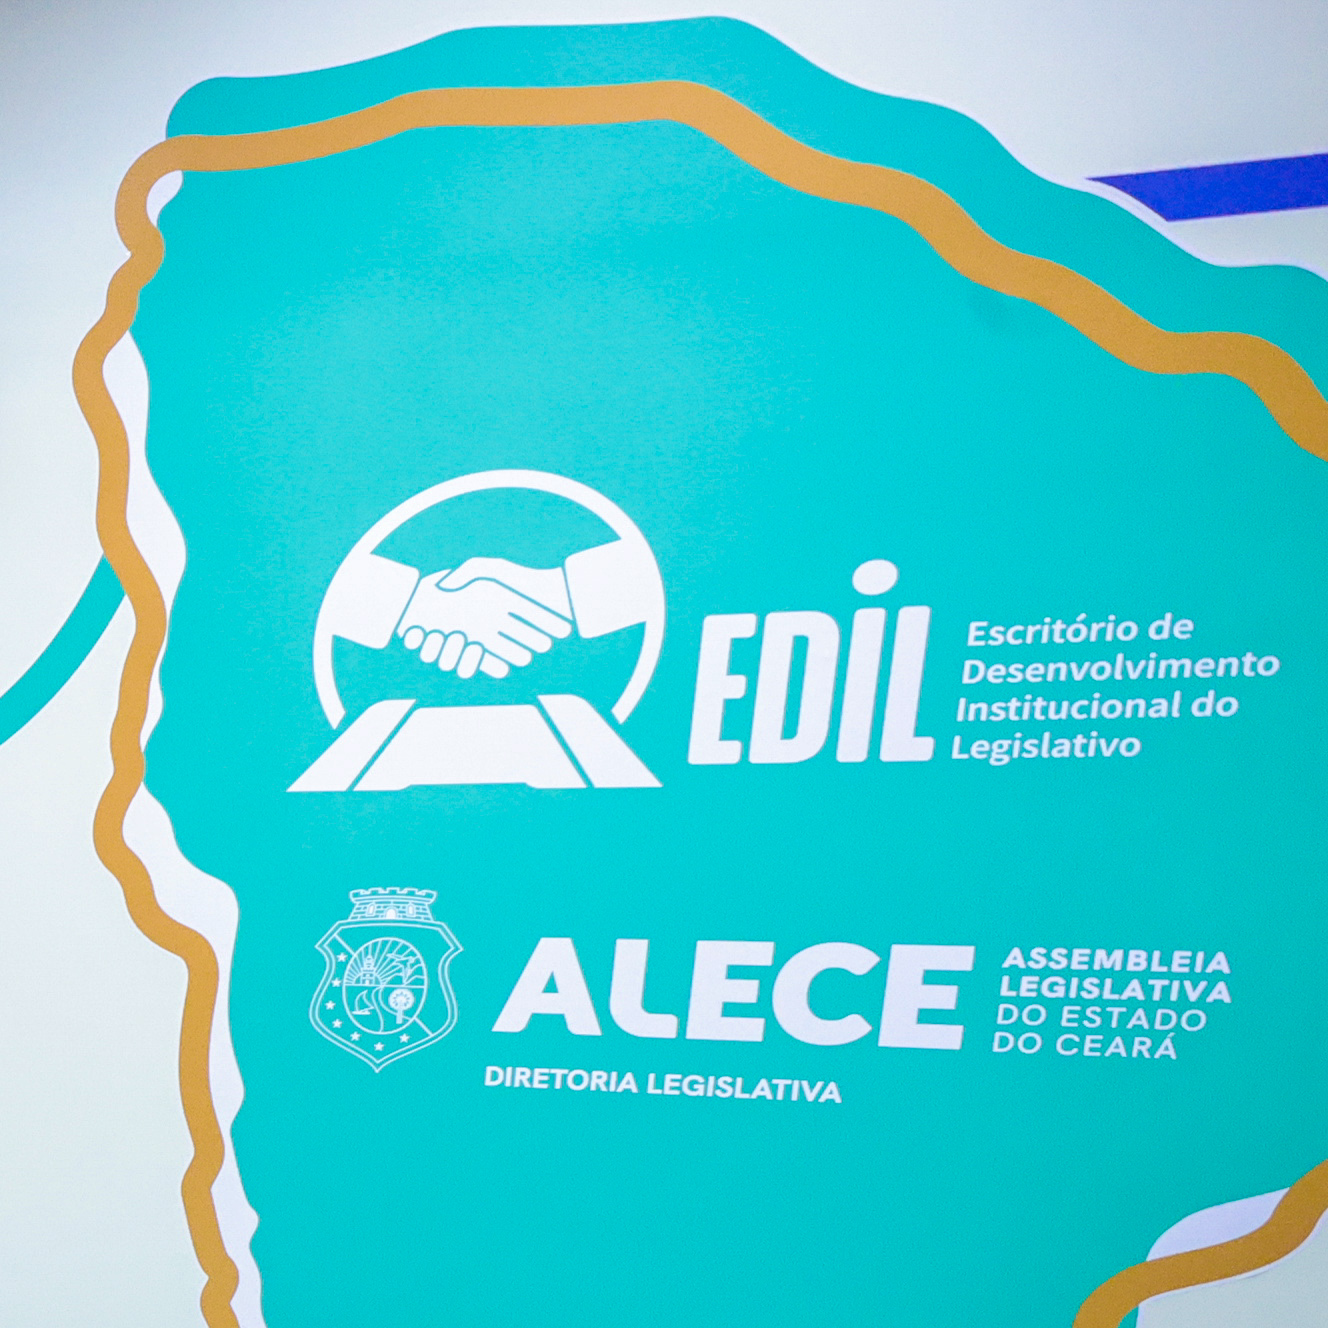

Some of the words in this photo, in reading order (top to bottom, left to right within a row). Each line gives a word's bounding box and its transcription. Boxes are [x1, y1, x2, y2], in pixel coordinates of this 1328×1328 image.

[968, 613, 1138, 646] Escritório
[1149, 613, 1194, 640] de
[962, 653, 1280, 683] Desenvolvimento
[958, 690, 1180, 721] Institucional
[1192, 690, 1238, 716] do
[952, 731, 1140, 765] Legislativo
[1002, 948, 1230, 973] ASSEMBLEIA
[492, 938, 975, 1049] ALECE
[1000, 976, 1230, 1003] LEGISLATIVA
[998, 1004, 1046, 1026] DO
[1062, 1006, 1206, 1031] ESTADO
[993, 1032, 1042, 1053] DO
[1055, 1033, 1176, 1059] CEARÁ
[485, 1066, 638, 1093] DIRETORIA
[648, 1073, 842, 1103] LEGISLATIVA
